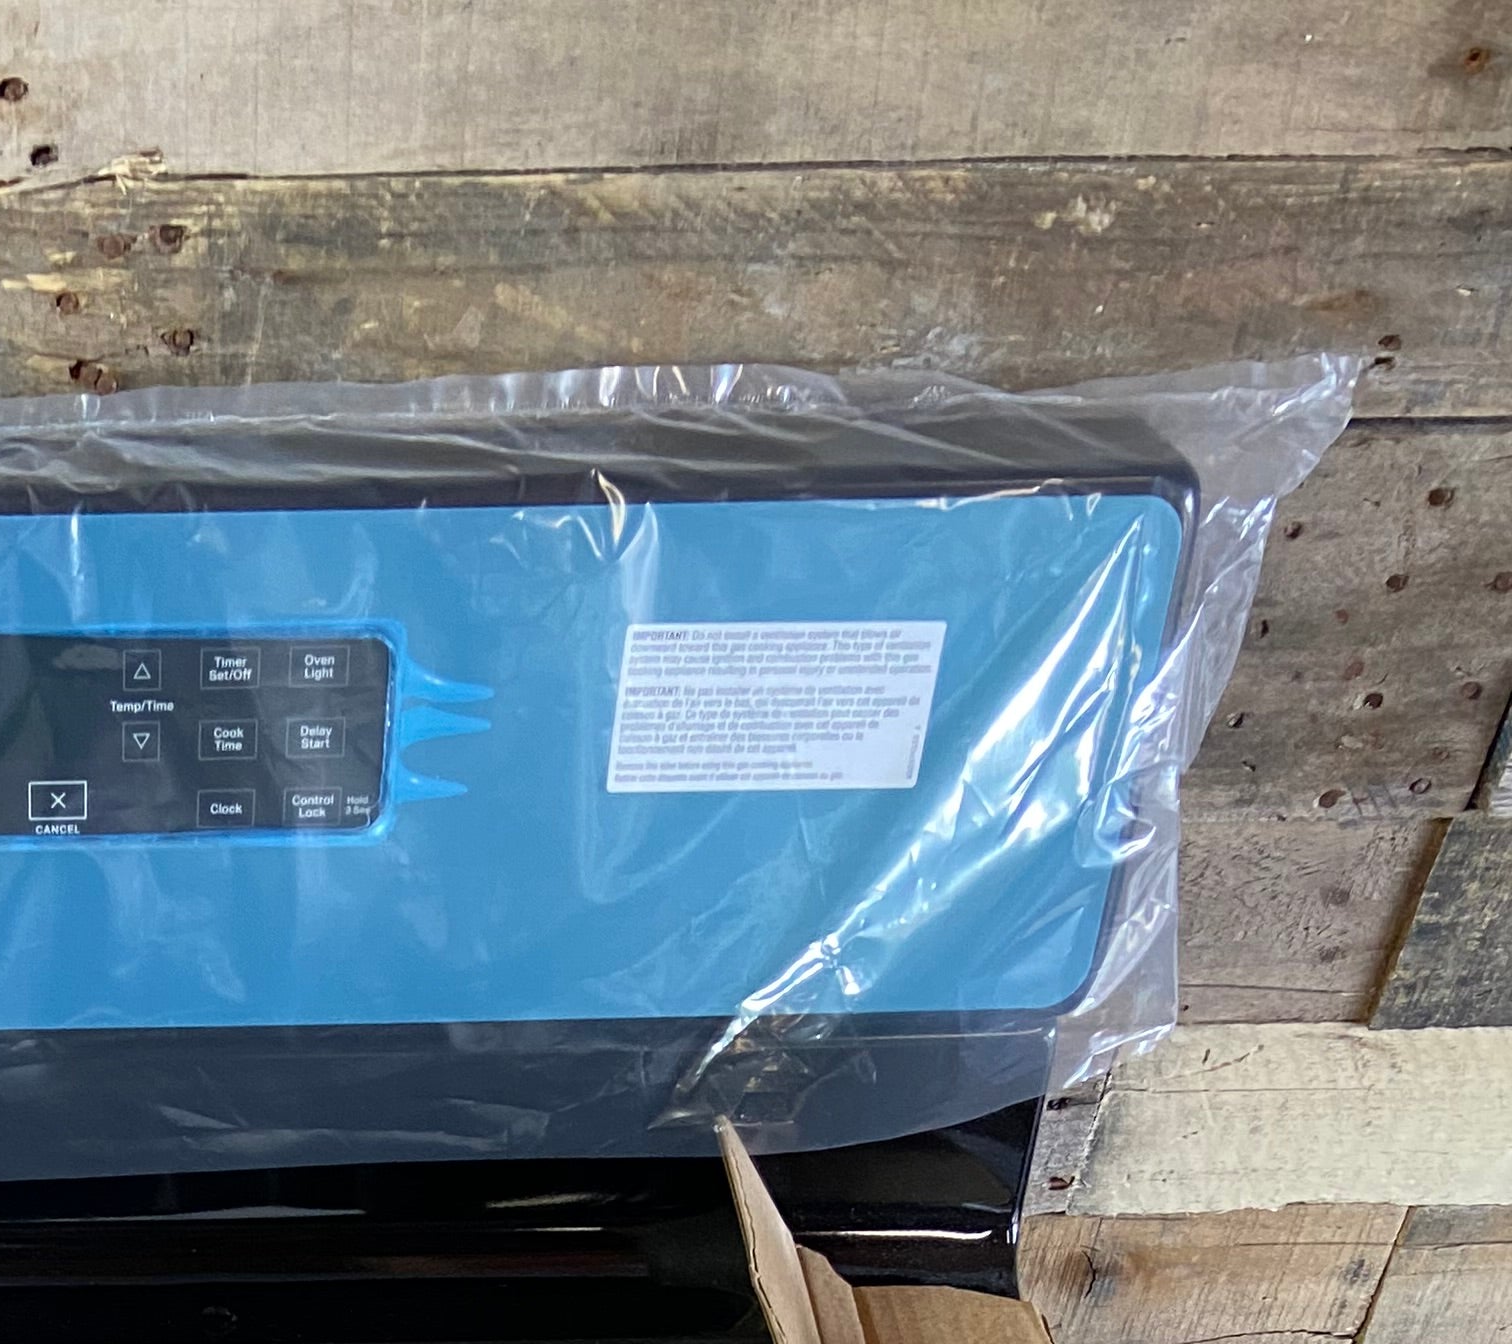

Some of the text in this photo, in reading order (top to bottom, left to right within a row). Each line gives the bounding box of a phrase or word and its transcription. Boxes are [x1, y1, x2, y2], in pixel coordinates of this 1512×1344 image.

[214, 655, 247, 668] Timer
[304, 654, 335, 666] Oven
[209, 667, 252, 682] Set/Off
[304, 667, 334, 681] Light
[110, 700, 175, 714] Temp/Time
[213, 727, 244, 739] Cook
[300, 725, 332, 738] Delay
[214, 740, 243, 752] Time
[301, 738, 330, 749] Start
[292, 794, 335, 807] Control
[210, 803, 243, 815] Clock
[298, 807, 326, 819] Lock
[35, 824, 81, 835] CANCEL
